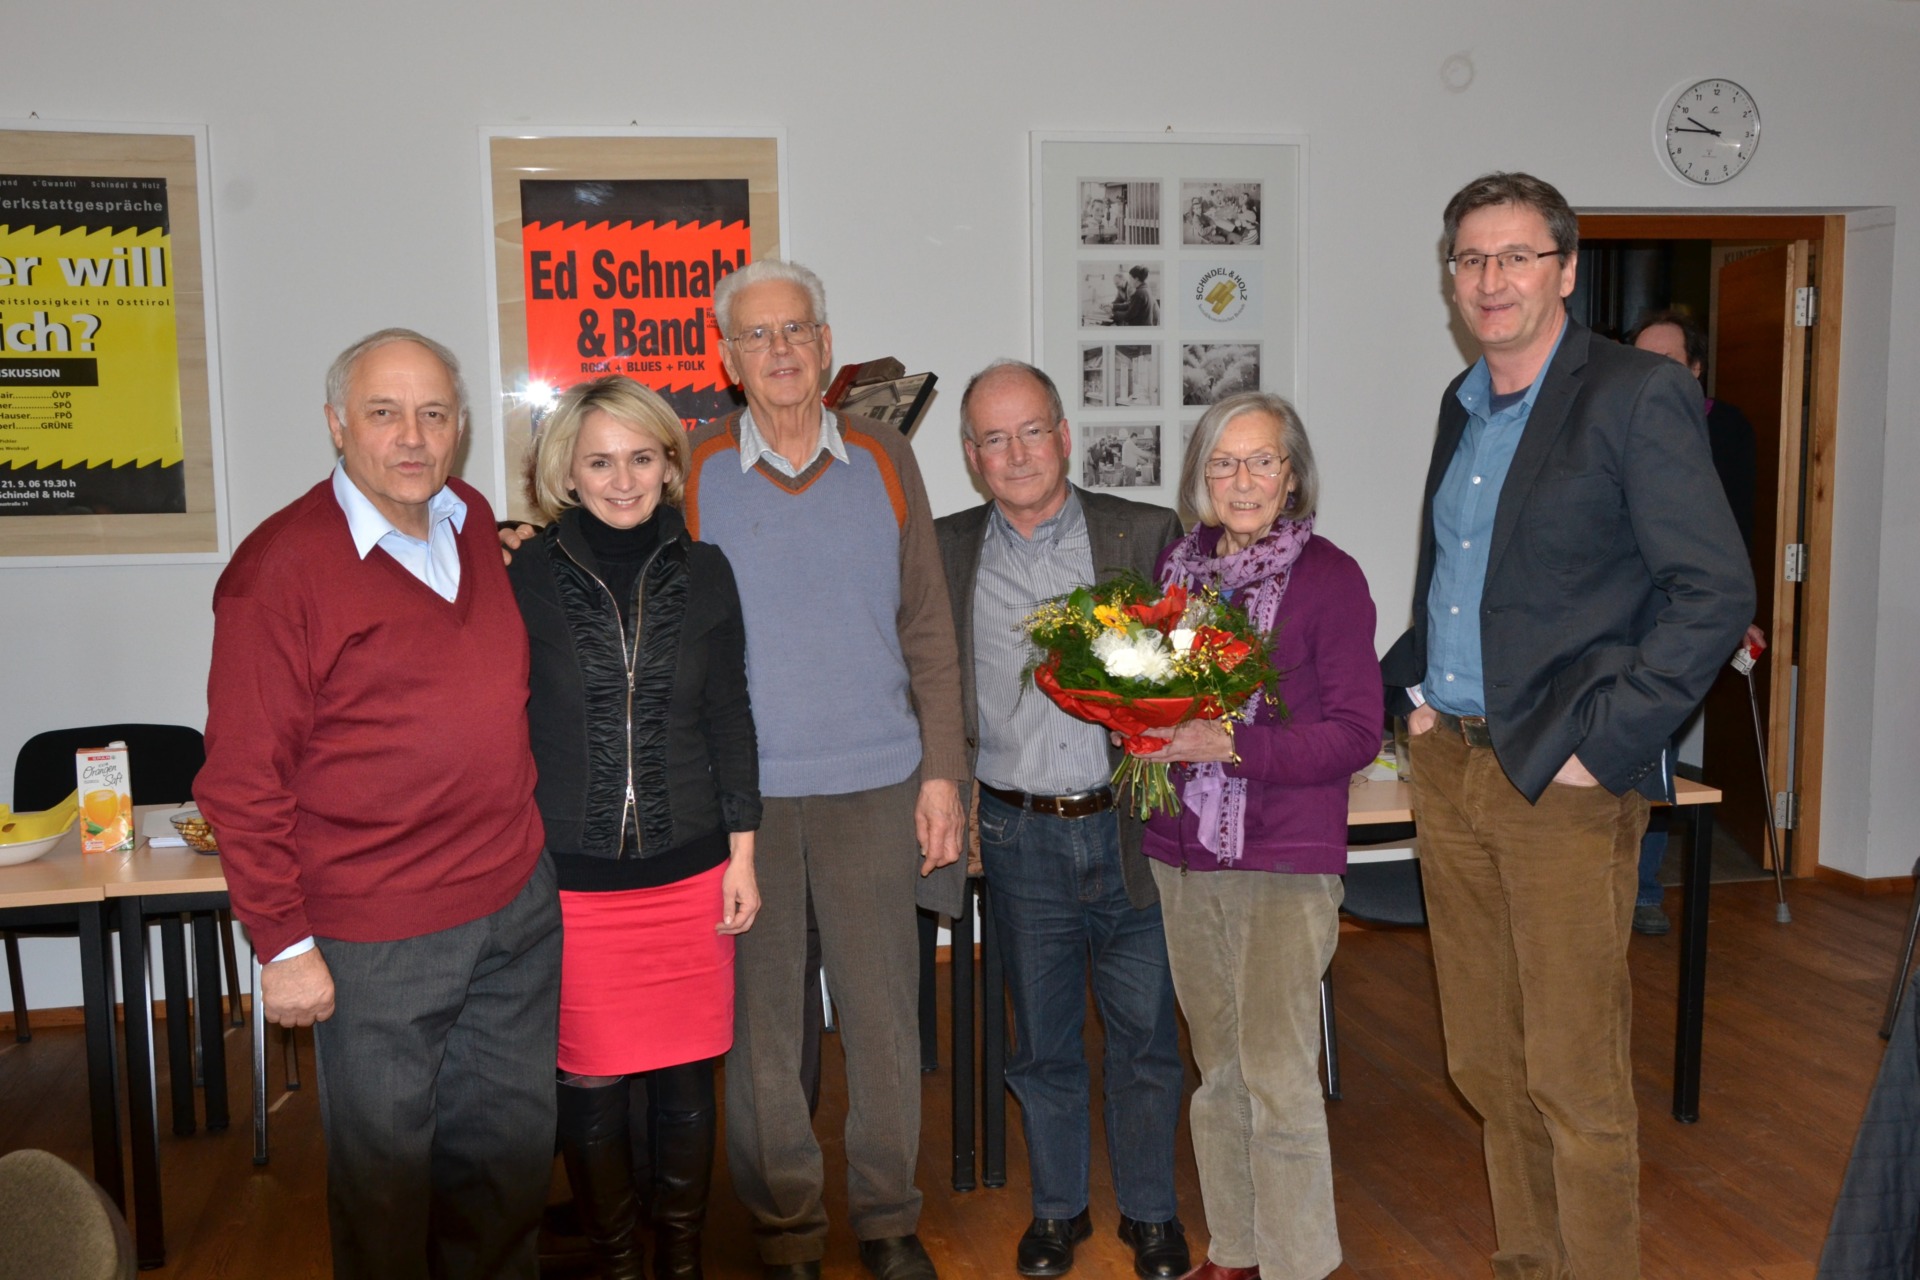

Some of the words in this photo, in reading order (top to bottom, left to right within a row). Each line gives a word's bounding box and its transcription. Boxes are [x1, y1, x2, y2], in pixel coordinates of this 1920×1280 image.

[0, 179, 18, 187] end
[91, 181, 128, 189] Schindel
[0, 197, 163, 213] erkstattgespräche
[57, 247, 167, 288] will
[530, 250, 578, 300] Ed
[1196, 268, 1227, 300] SCHINDEL
[1228, 270, 1235, 278] &
[1234, 275, 1247, 300] HOLZ
[97, 298, 109, 306] in
[577, 308, 607, 358] &
[612, 307, 706, 357] Band
[0, 368, 60, 378] SKUSSION
[581, 362, 611, 373] ROCK
[627, 361, 662, 372] BLUES
[677, 360, 705, 371] FOLK
[28, 480, 41, 488] 06
[43, 479, 68, 488] 19.30
[69, 479, 76, 487] h
[52, 490, 75, 498] Holz
[83, 765, 117, 779] Orangen
[103, 772, 122, 786] Saft
